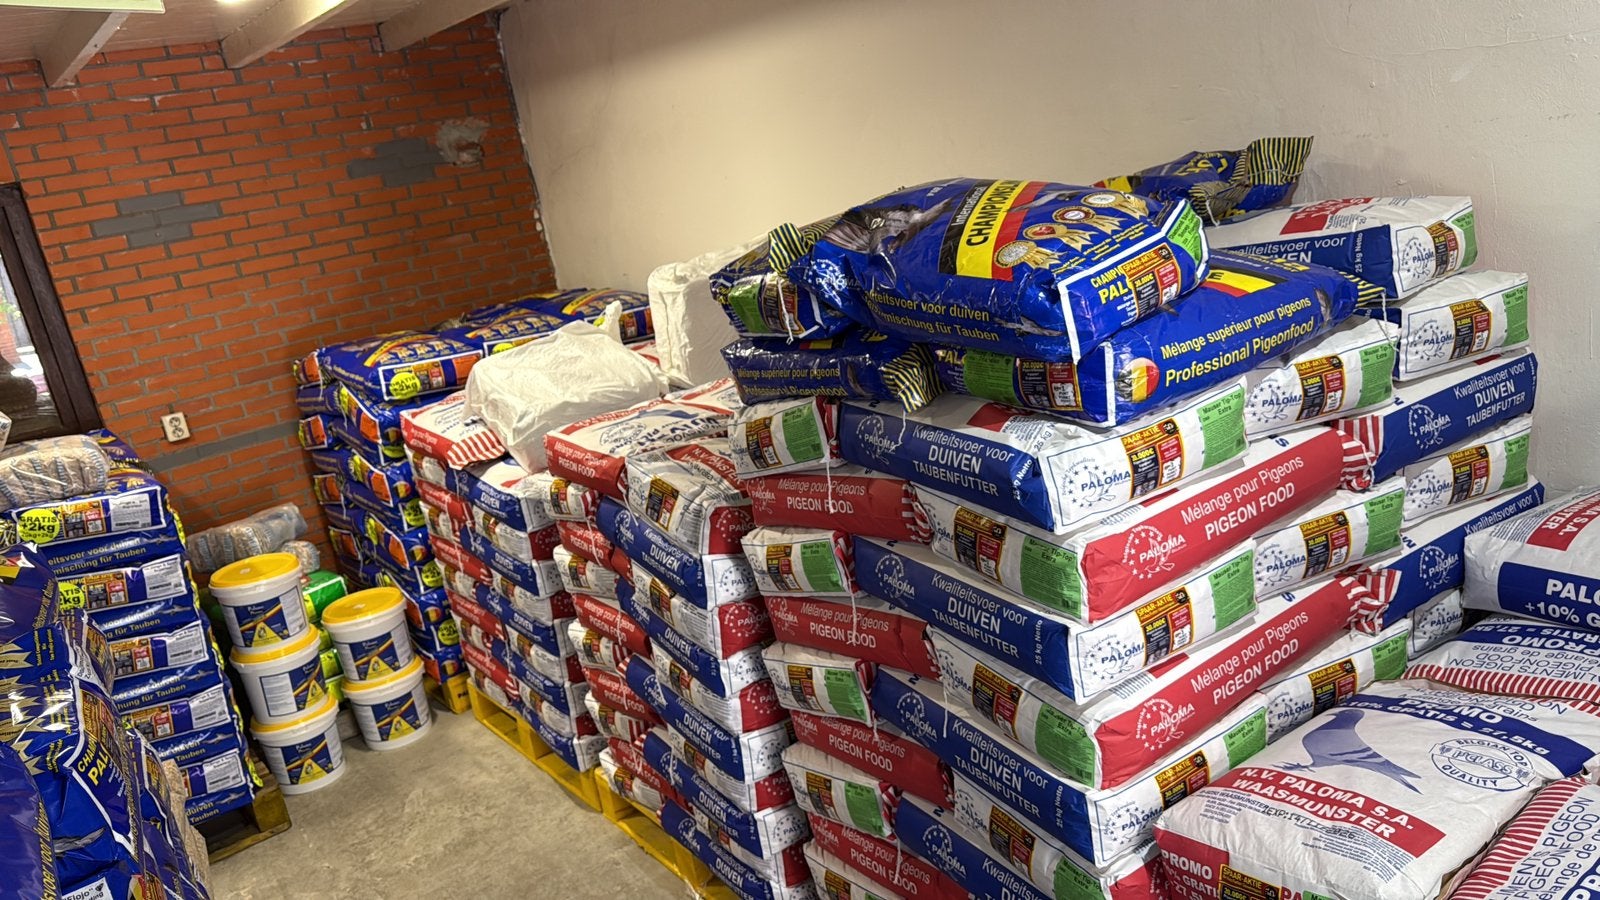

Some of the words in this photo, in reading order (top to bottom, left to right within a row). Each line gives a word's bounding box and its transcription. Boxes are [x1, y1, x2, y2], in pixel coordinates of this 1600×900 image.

[951, 185, 987, 226] International
[1315, 236, 1347, 248] voor
[1354, 233, 1363, 250] Netto
[920, 303, 947, 316] voor
[949, 305, 990, 322] duiven
[935, 321, 952, 333] für
[953, 325, 1000, 342] Tauben
[1161, 335, 1206, 360] Mélange
[1207, 318, 1253, 344] supérieur
[1255, 311, 1276, 330] pour
[1277, 296, 1312, 322] pigeons
[1165, 347, 1250, 387] Professional
[1251, 316, 1315, 357] Pigeonfood
[1453, 370, 1511, 400] Kwaliteitsvoer
[1509, 362, 1527, 377] voor
[1474, 381, 1516, 408] DUIVEN
[1202, 401, 1222, 416] Mauser
[1218, 405, 1232, 416] Extra
[1465, 391, 1526, 428] TAUBENFUTTER
[1418, 414, 1451, 435] PALOMA
[864, 433, 897, 451] PALOMA
[912, 424, 984, 458] Kwaliteitsvoer
[984, 446, 1016, 463] voor
[928, 444, 982, 475] DUIVEN
[778, 478, 809, 494] Mélange
[830, 484, 866, 497] Pigeons
[912, 459, 1000, 498] TAUBENFUTTER
[1081, 470, 1131, 492] PALOMA
[1180, 490, 1233, 526] Mélange
[1234, 477, 1260, 500] pour
[1259, 454, 1305, 487] Pigeons
[786, 497, 822, 512] PIGEON
[1204, 505, 1258, 541] PIGEON
[1259, 482, 1296, 514] FOOD
[1516, 495, 1534, 511] voor
[22, 522, 55, 534] +2kg
[87, 545, 109, 556] voor
[100, 554, 113, 564] für
[114, 546, 147, 560] Tauben
[649, 543, 681, 572] DUIVEN
[1139, 534, 1186, 564] PALOMA
[1266, 554, 1306, 572] PALOMA
[883, 574, 915, 596] PALOMA
[931, 573, 1001, 613] Kwaliteitsvoer
[1002, 606, 1028, 627] voor
[1136, 594, 1174, 618] SPAAR-AKTIE
[1525, 601, 1580, 624] +10%
[129, 618, 161, 632] Tauben
[800, 602, 833, 619] Mélange
[855, 614, 890, 632] Pigeons
[947, 597, 1001, 635] DUIVEN
[664, 626, 692, 658] DUIVEN
[809, 622, 845, 642] PIGEON
[931, 608, 1020, 659] TAUBENFUTTER
[1034, 619, 1043, 641] Netto
[1190, 660, 1241, 693] Mélange
[1242, 638, 1267, 664] pour
[1264, 611, 1309, 644] Pigeons
[1472, 644, 1519, 654] grains
[1475, 652, 1595, 672] PIGEONFOOD
[1520, 649, 1541, 658] de
[1212, 663, 1263, 704] PIGEON
[1264, 637, 1300, 671] FOOD
[1449, 658, 1514, 672] PIGEON
[156, 684, 187, 699] Tauben
[905, 711, 938, 739] PALOMA
[1150, 703, 1196, 736] PALOMA
[1386, 705, 1458, 722] GRATIS
[1399, 699, 1503, 724] PROMO
[683, 713, 713, 744] DUIVEN
[828, 734, 864, 757] PIGEON
[865, 749, 894, 772] FOOD
[952, 718, 1022, 772] Kwaliteitsvoer
[1022, 765, 1049, 790] voor
[1456, 739, 1510, 752] BELGIAN
[1509, 751, 1528, 768] TOP
[87, 753, 109, 786] PAL
[970, 746, 1022, 792] DUIVEN
[1156, 757, 1192, 783] SPAAR-AKTIE
[1442, 764, 1498, 787] QUALITY
[954, 755, 1041, 818] TAUBENFUTTER
[1055, 785, 1064, 804] Netto
[1239, 768, 1275, 781] N.V.
[1280, 775, 1367, 808] PALOMA
[1370, 807, 1415, 830] S.A.
[699, 791, 727, 823] DUIVEN
[1232, 779, 1397, 839] WAASMUNSTER
[1542, 796, 1596, 848] PIGEON
[850, 847, 888, 877] PIGEON
[875, 844, 897, 864] pour
[931, 846, 967, 876] PALOMA
[1576, 843, 1598, 859] de
[715, 858, 744, 888] DUIVEN
[1161, 849, 1213, 881] PROMO
[1222, 866, 1262, 891] SPAAR-AKTIE
